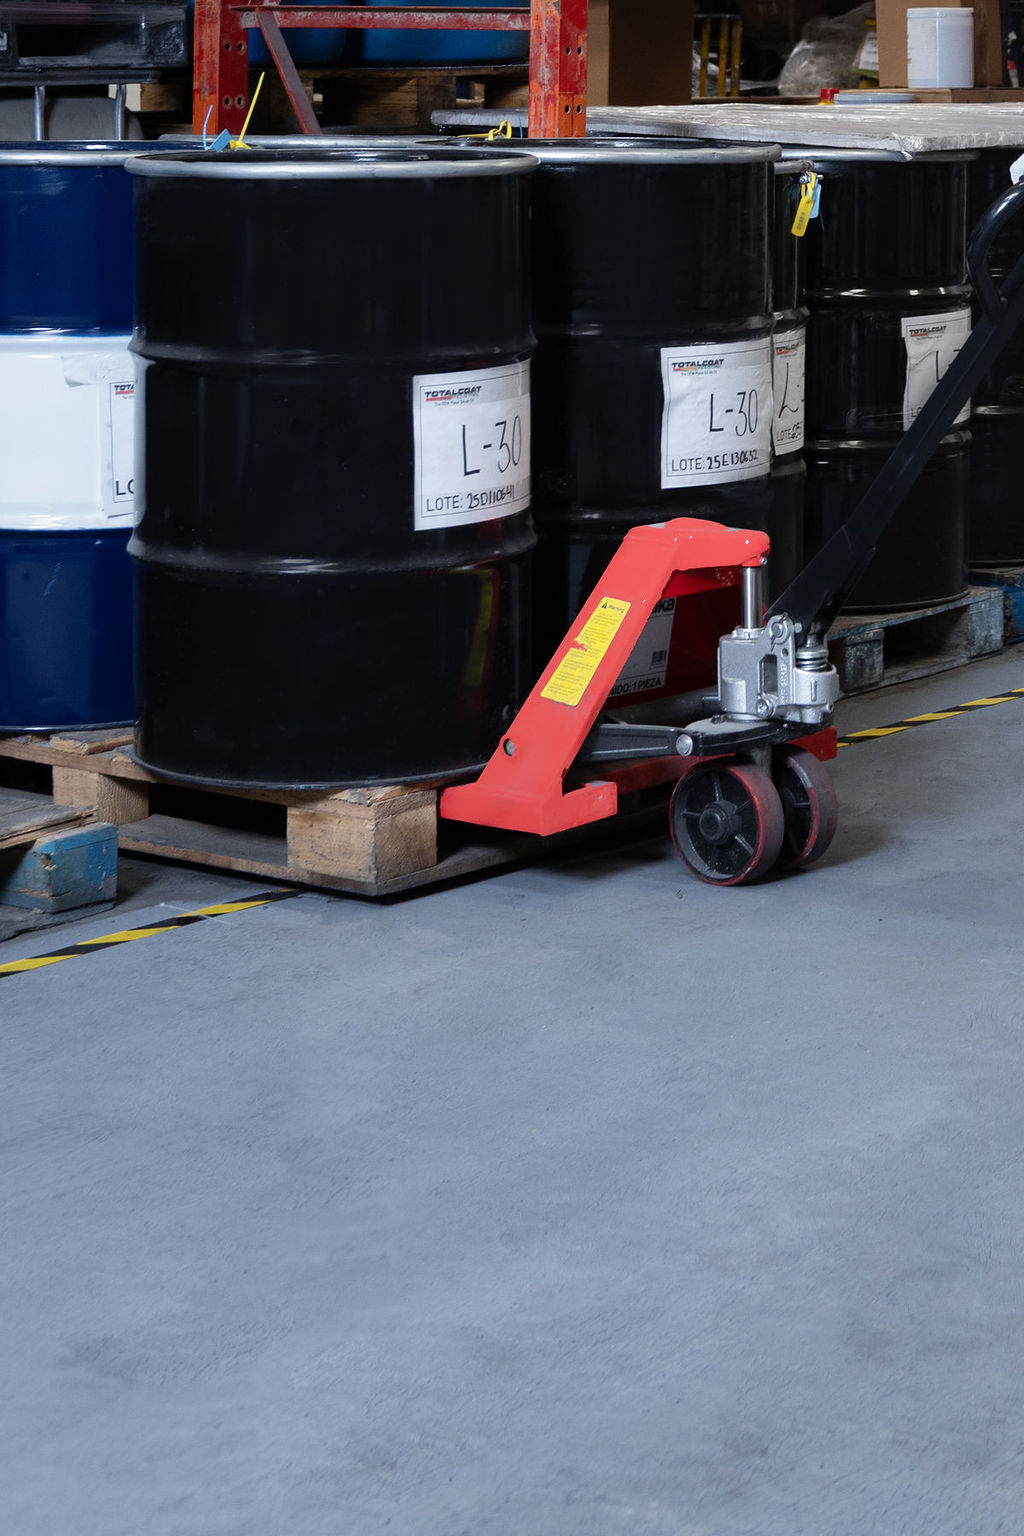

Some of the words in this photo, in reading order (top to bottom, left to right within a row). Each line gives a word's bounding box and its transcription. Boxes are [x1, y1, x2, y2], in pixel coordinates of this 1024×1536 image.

[671, 358, 725, 369] TOTALCOAT
[424, 385, 483, 398] TOTALCOAT
[709, 388, 759, 437] L-30
[461, 415, 523, 477] L-30
[671, 457, 704, 472] LOTE:
[426, 493, 464, 512] LOTE:
